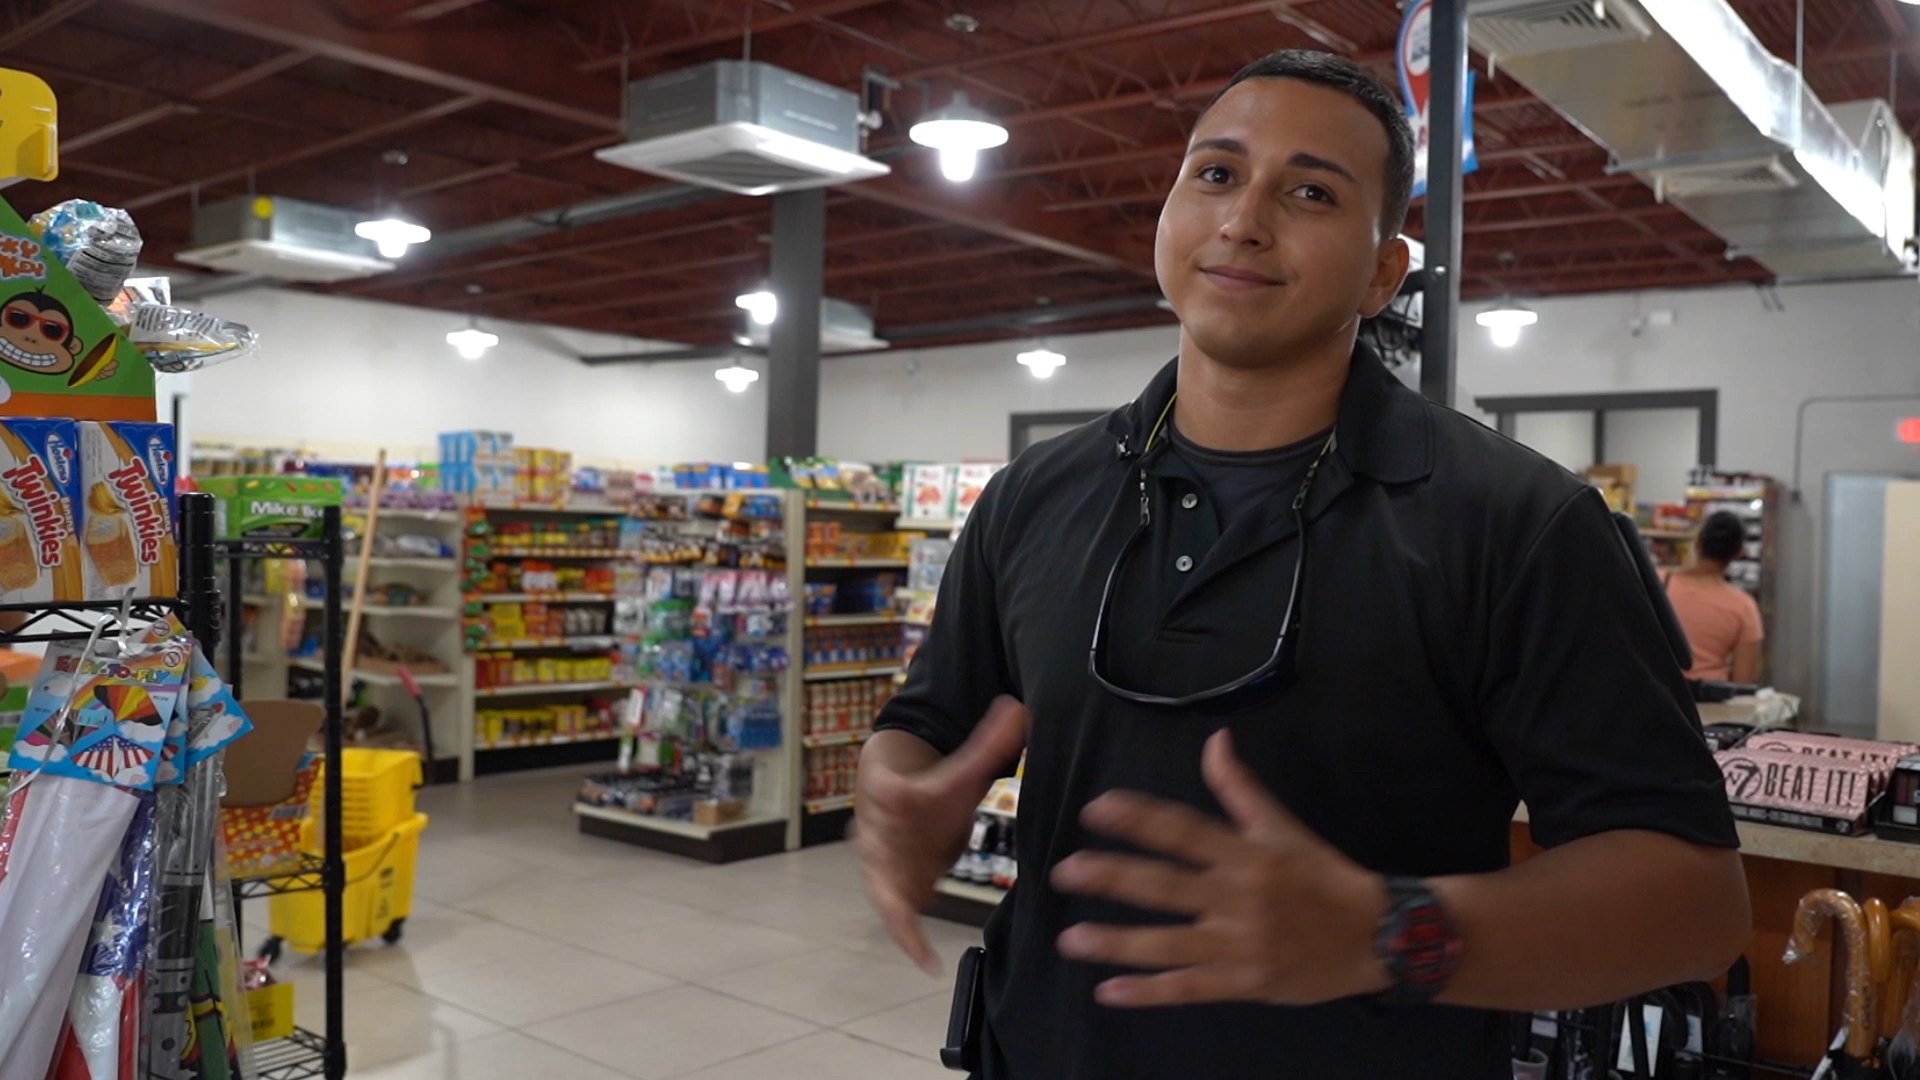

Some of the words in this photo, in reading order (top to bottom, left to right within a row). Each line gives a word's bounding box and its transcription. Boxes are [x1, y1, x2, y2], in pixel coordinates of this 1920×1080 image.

[2, 455, 68, 565] Twinkies
[108, 457, 164, 563] Twinkies
[251, 501, 298, 515] Mike
[1765, 763, 1819, 801] BEAT
[1825, 769, 1857, 807] IT!
